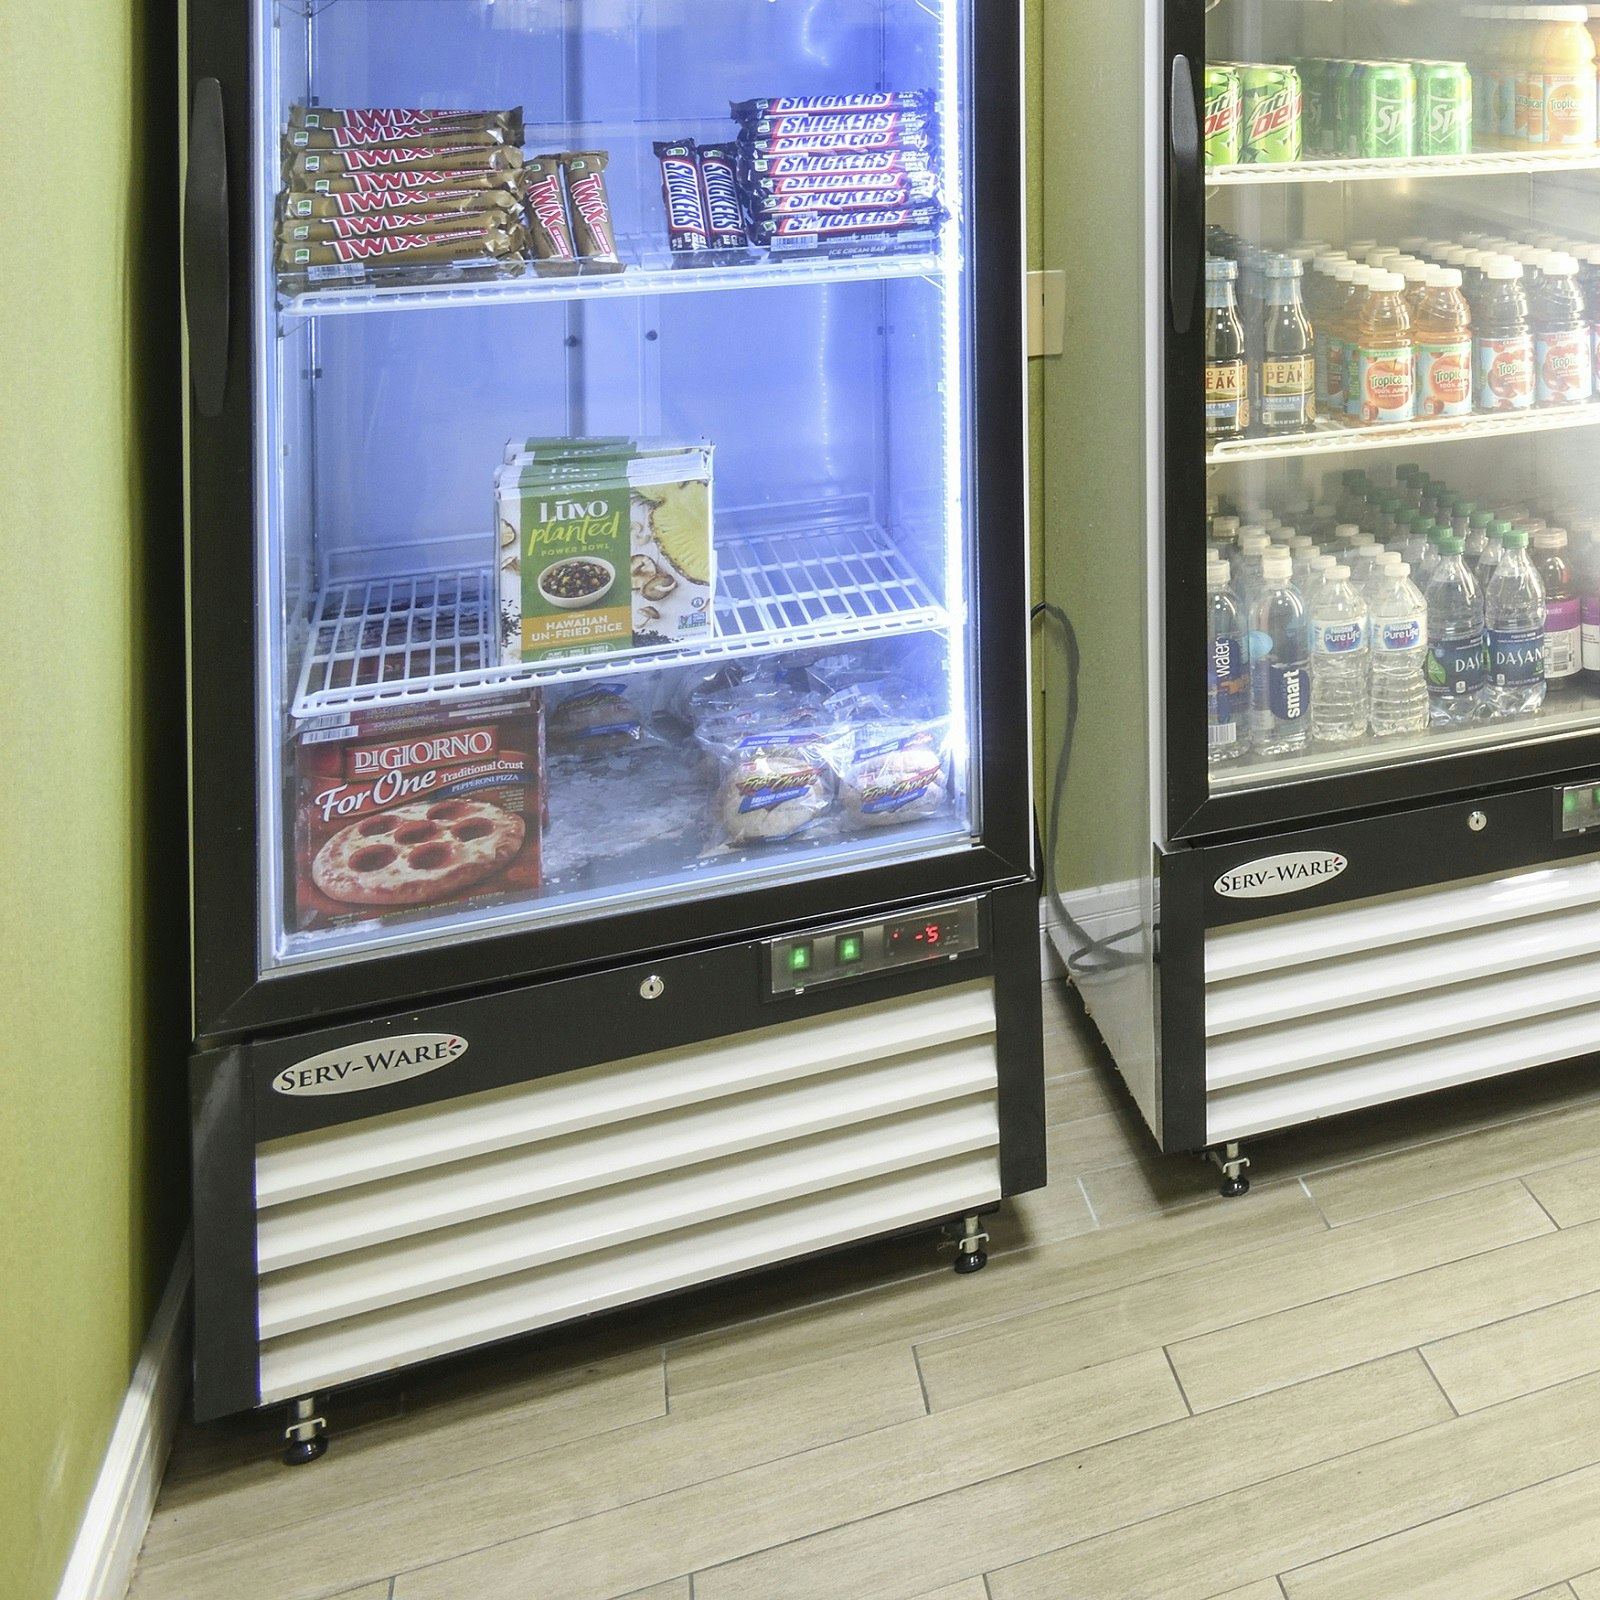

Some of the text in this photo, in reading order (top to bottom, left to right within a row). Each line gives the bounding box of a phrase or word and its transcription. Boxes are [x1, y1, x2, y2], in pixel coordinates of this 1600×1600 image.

[780, 112, 895, 134] SNICKERS
[526, 174, 567, 228] TWIX
[569, 172, 609, 225] TWIX
[664, 161, 701, 233] SNICKERS
[705, 163, 742, 232] SNICKERS
[322, 233, 429, 263] TWIX
[1266, 371, 1304, 385] PEAK
[527, 510, 621, 557] planted
[540, 542, 611, 556] POWER BOWL
[531, 621, 623, 642] UN-FRIED RICE
[545, 615, 608, 631] HAWAIIAN
[1324, 629, 1361, 644] Pure Life
[1383, 627, 1420, 641] Pure Life
[1286, 669, 1300, 719] smart
[440, 759, 525, 784] Traditional Crust
[451, 773, 520, 793] PEPPERONI PIZZA
[314, 769, 437, 823] For One
[1220, 858, 1335, 894] SERV-WARE
[278, 1041, 449, 1093] SERV-WARE
